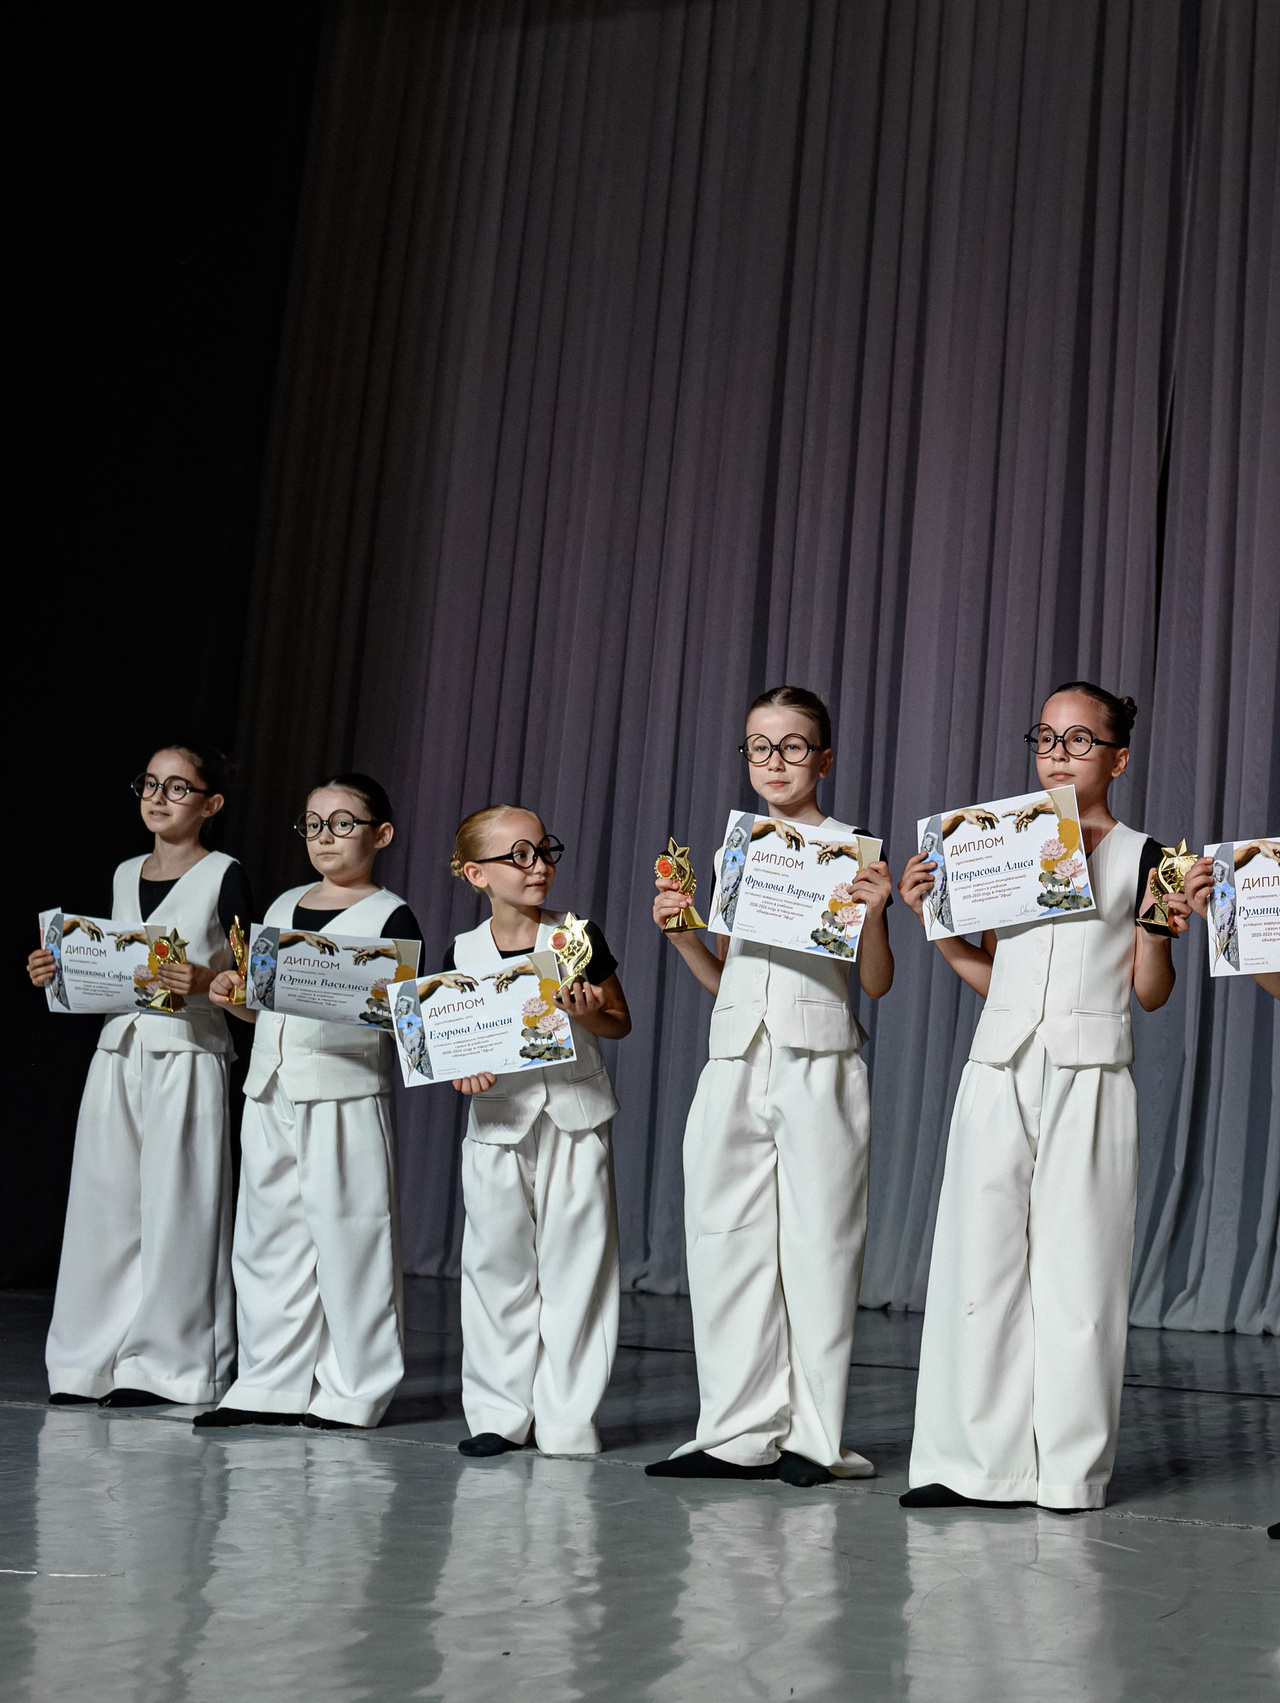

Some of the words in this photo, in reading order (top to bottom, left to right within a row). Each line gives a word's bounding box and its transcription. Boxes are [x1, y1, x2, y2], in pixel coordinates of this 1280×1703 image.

[950, 836, 1004, 857] ДИПЛОМ
[752, 851, 804, 870] ДИПЛОМ
[951, 866, 1000, 881] Некрасова
[1004, 860, 1033, 871] Алиса
[745, 875, 784, 892] Фролова
[787, 884, 825, 902] Варвара
[65, 945, 107, 957] ДИПЛОМ
[283, 956, 340, 970] ДИПЛОМ
[108, 971, 132, 982] София
[280, 974, 316, 985] Юрина
[321, 979, 368, 991] Василиса
[429, 998, 485, 1019] ДИПЛОМ
[430, 1027, 470, 1040] Егорова
[474, 1017, 512, 1031] Анисия
